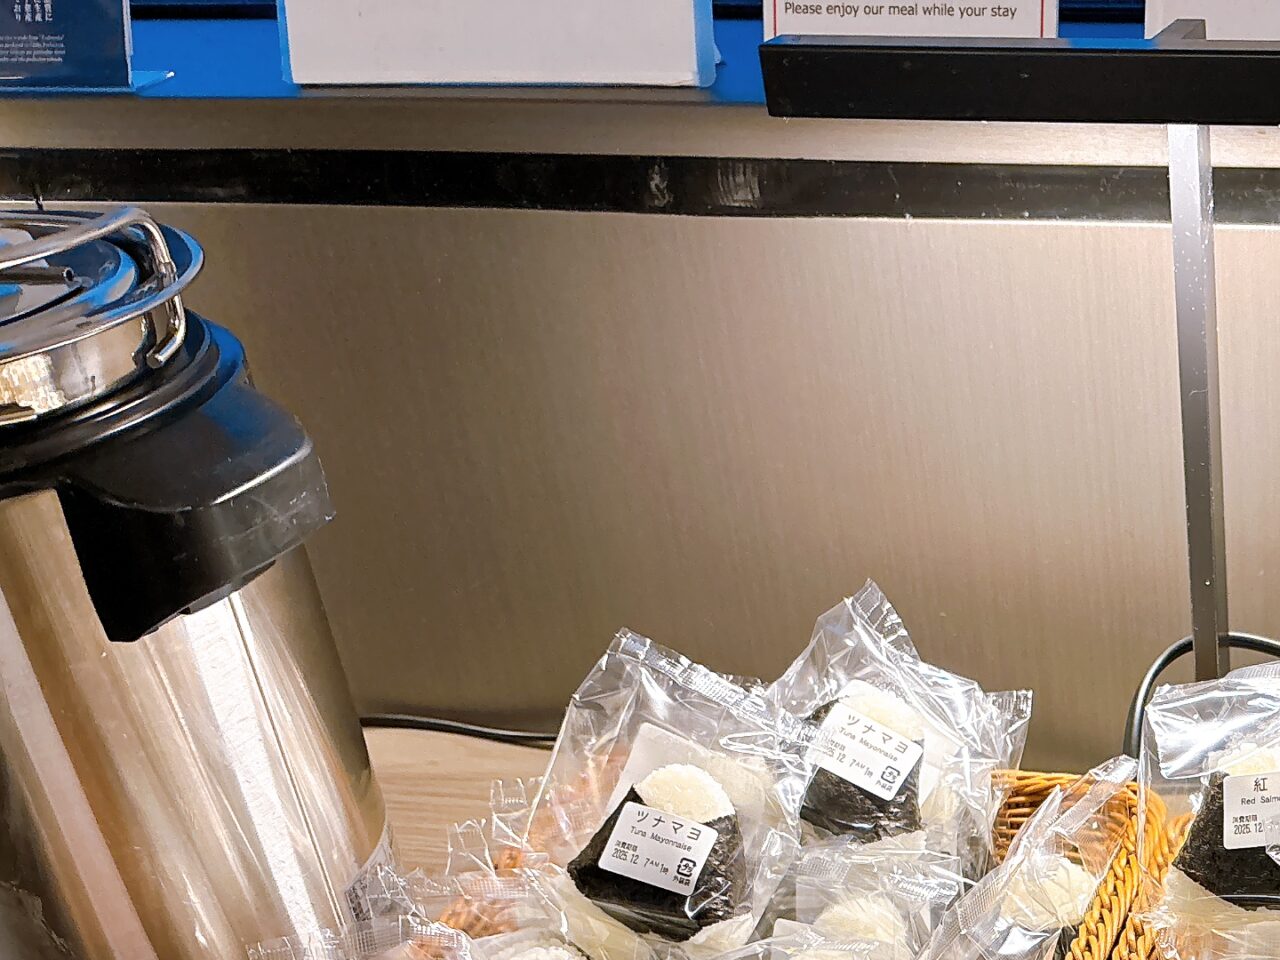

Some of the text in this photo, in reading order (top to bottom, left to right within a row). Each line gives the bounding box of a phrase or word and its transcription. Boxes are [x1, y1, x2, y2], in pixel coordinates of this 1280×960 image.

[785, 2, 1018, 19] Please enjoy our meal while your stay
[839, 727, 856, 740] Tuna
[848, 715, 908, 754] ツナマヨ
[1241, 797, 1256, 805] Red
[637, 810, 701, 841] ツナマヨ
[630, 826, 693, 852] Tuna Mayonnaise
